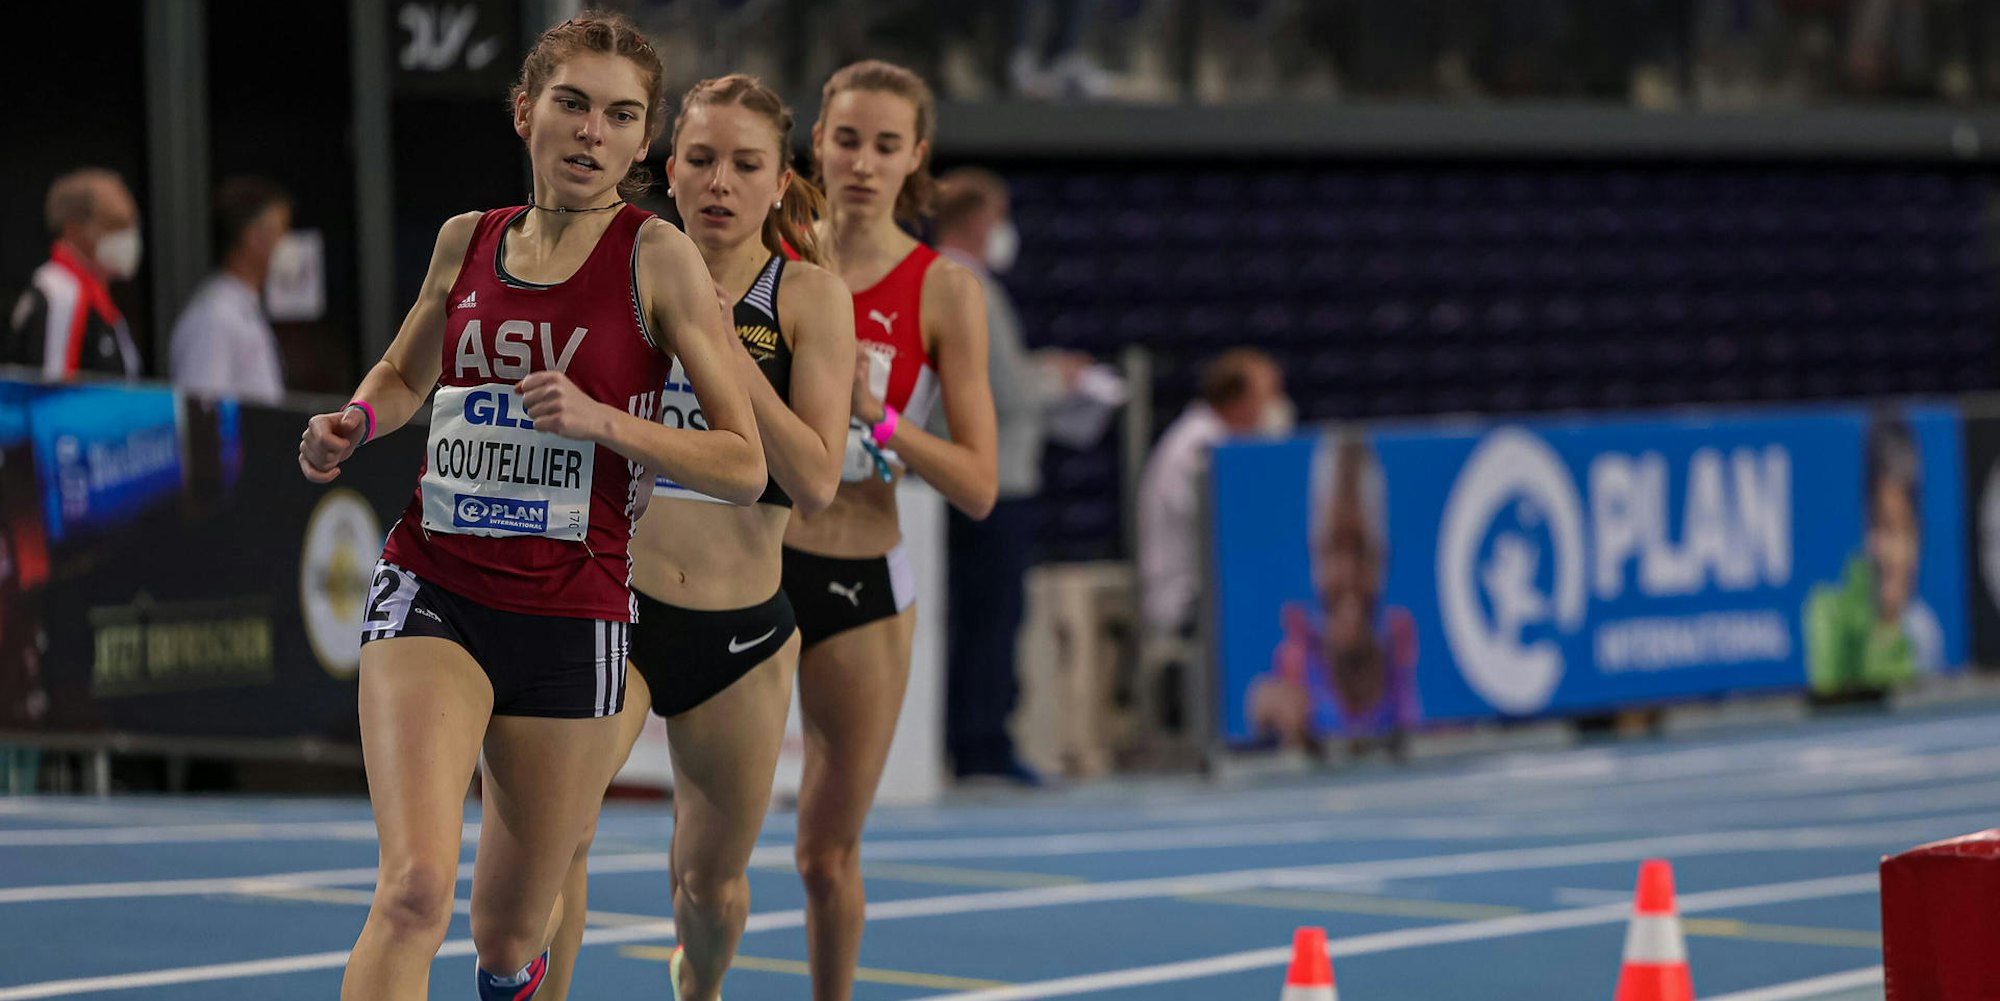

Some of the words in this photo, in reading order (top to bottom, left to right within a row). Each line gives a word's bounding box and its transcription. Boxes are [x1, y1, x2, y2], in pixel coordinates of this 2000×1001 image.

[454, 318, 589, 381] ASV
[436, 437, 583, 490] COUTELLIER
[489, 519, 543, 530] INTERNATIONAL
[491, 503, 544, 523] PLAN
[568, 509, 580, 529] 170
[1589, 442, 1793, 598] PLAN
[367, 569, 401, 622] 2
